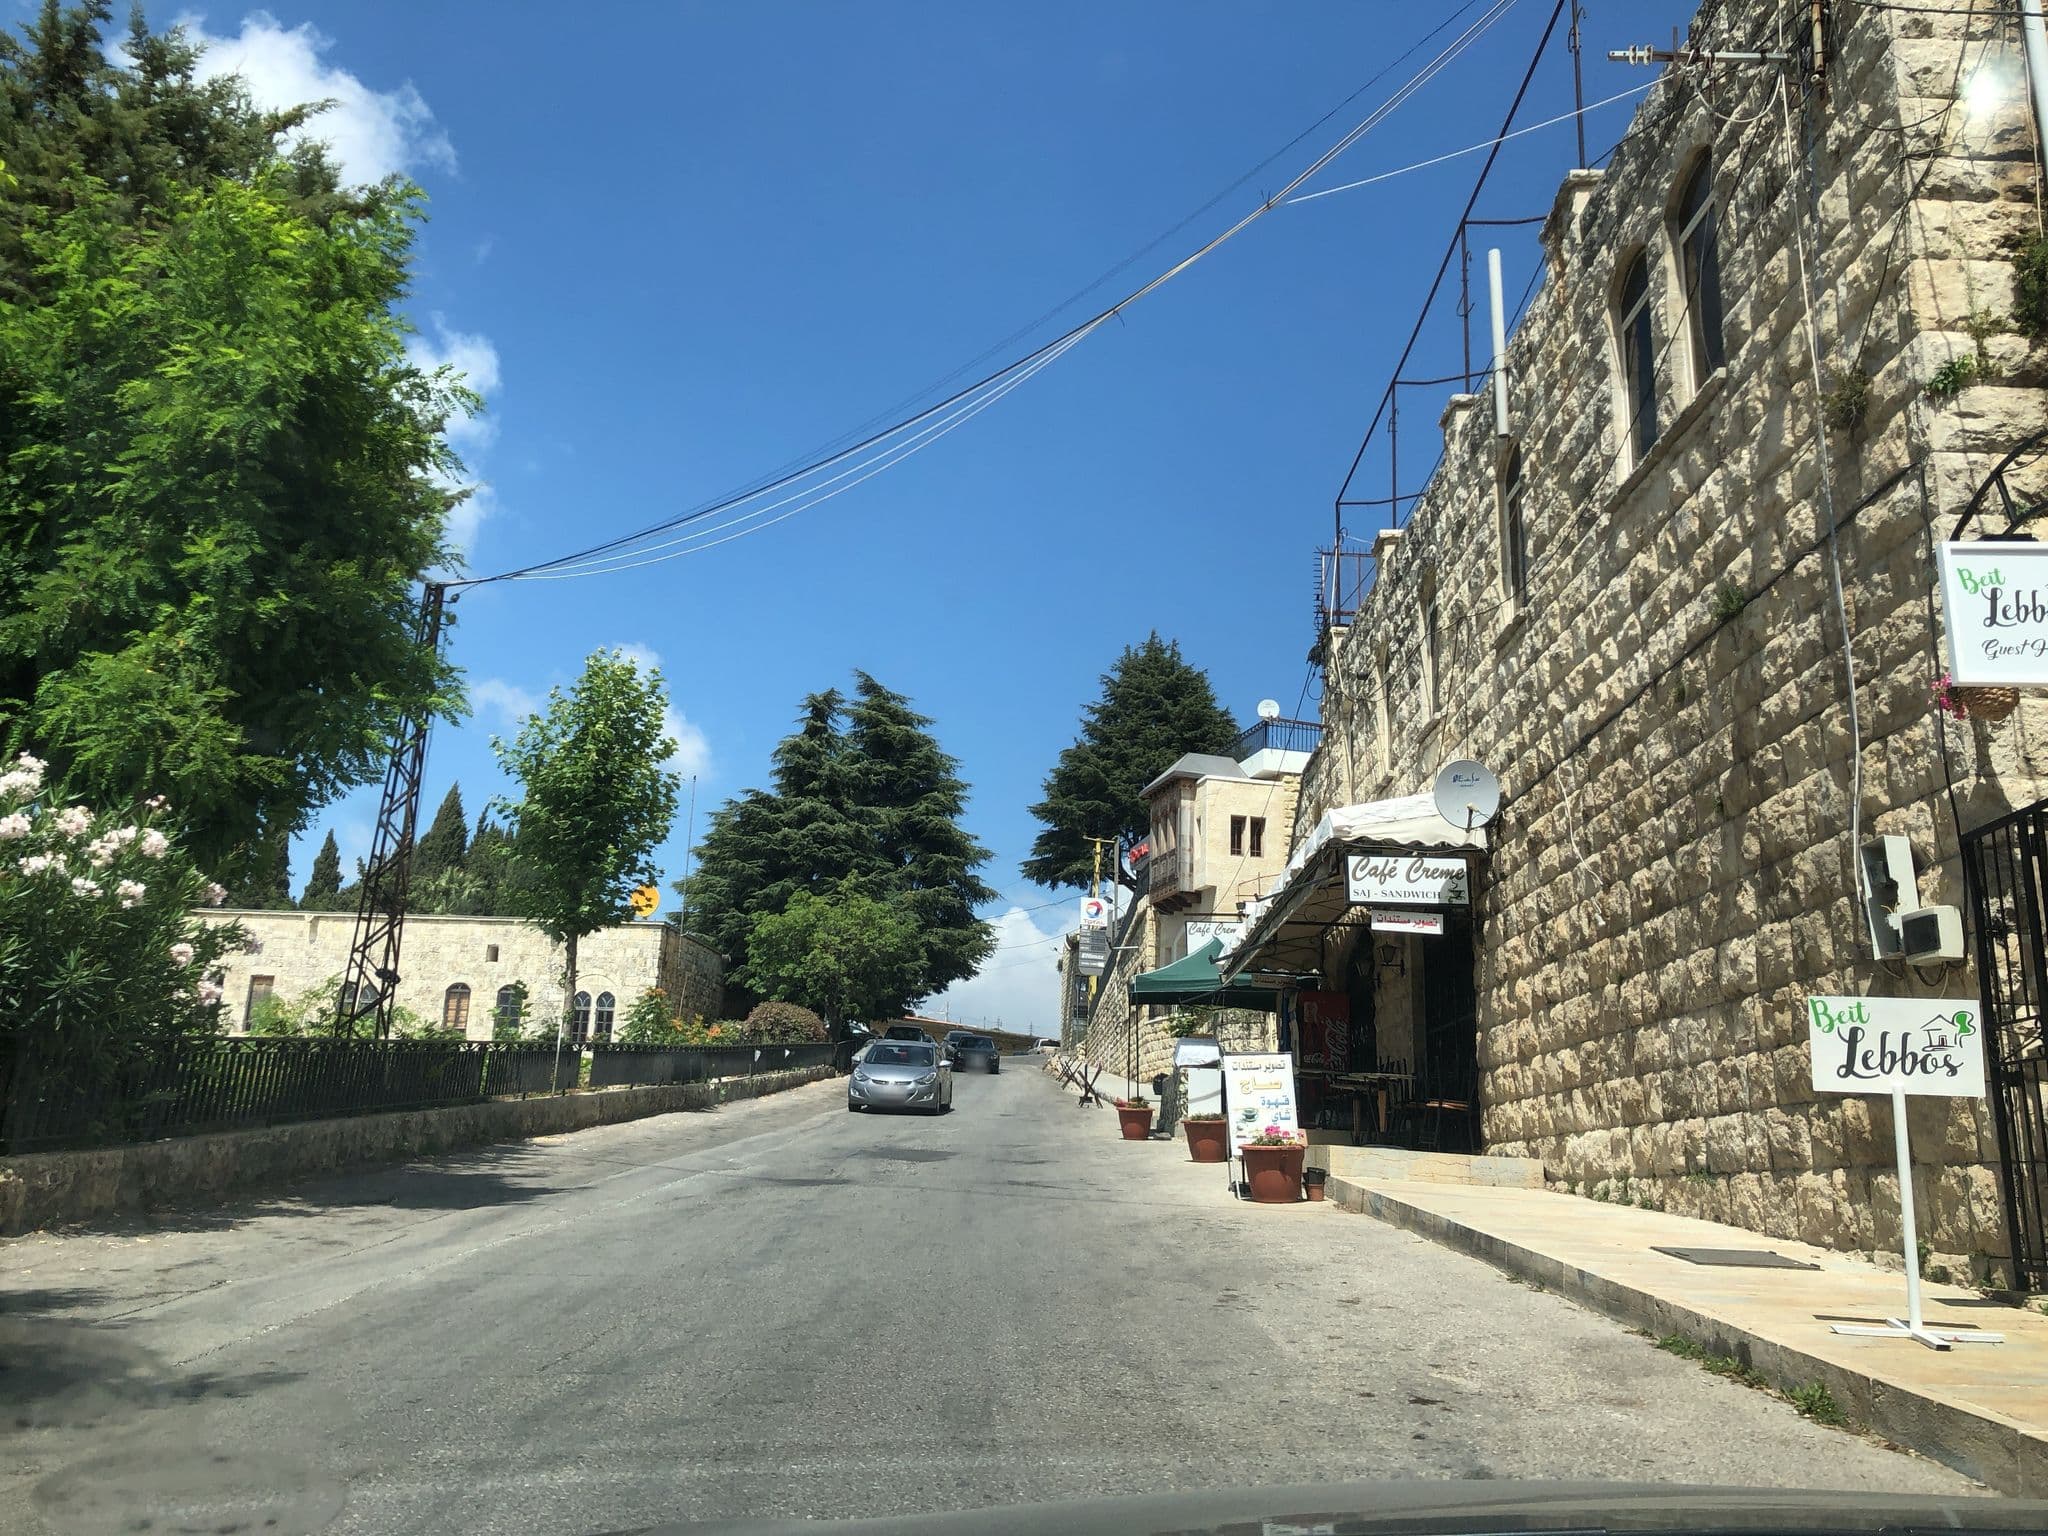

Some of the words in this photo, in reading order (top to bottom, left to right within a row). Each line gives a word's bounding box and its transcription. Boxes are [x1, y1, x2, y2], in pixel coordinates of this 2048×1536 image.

[1957, 568, 2006, 595] Beit
[1981, 587, 2048, 628] Lebb
[1982, 638, 2030, 661] Guest
[1352, 856, 1399, 885] Café
[1405, 857, 1465, 883] Creme
[1353, 889, 1371, 898] SAJ
[1381, 889, 1441, 899] SANDWICH
[1188, 922, 1210, 937] Café
[1214, 921, 1237, 936] Crem
[1809, 998, 1870, 1034] Beit
[1837, 1026, 1964, 1079] Lebbos
[1264, 1060, 1286, 1073] تصوير
[1261, 1095, 1290, 1109] قهوة
